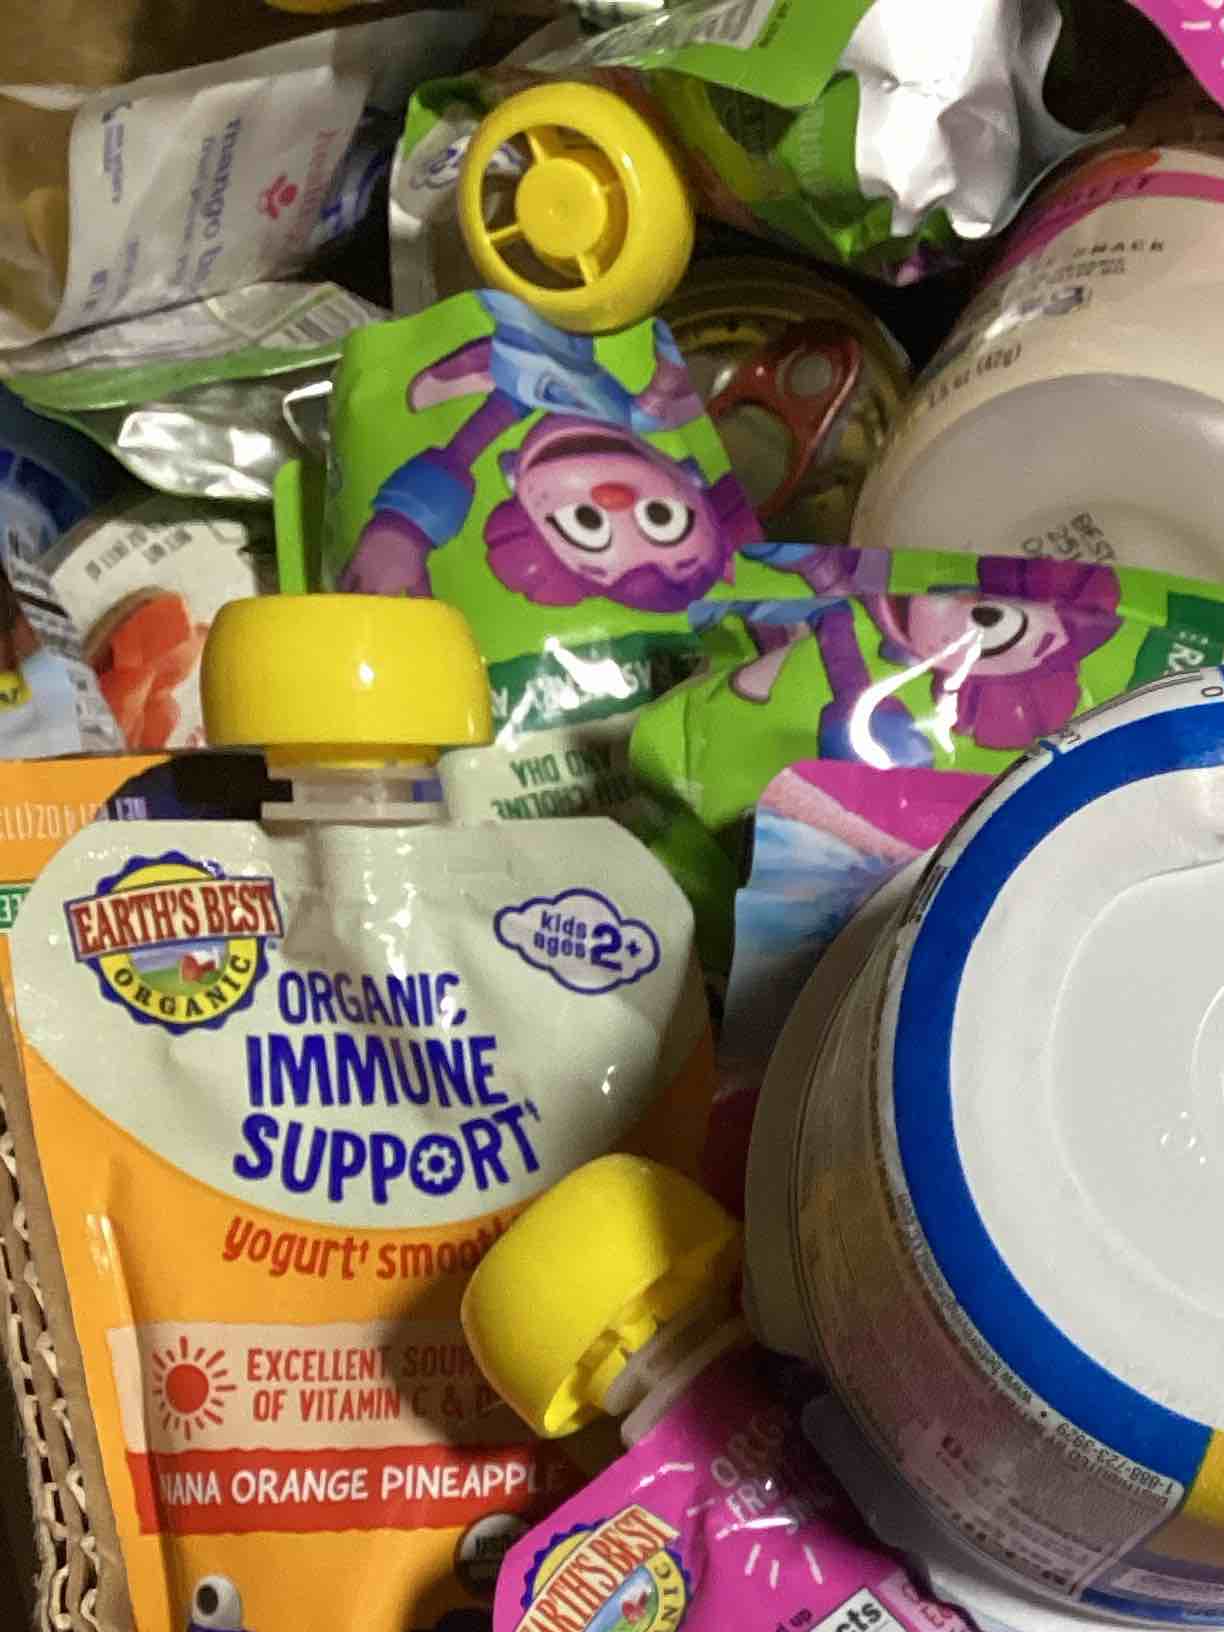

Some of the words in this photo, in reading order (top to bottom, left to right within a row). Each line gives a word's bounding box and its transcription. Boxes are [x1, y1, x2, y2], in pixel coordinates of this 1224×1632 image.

[71, 883, 202, 954] EARTH'S
[205, 879, 277, 938] BEST
[540, 911, 588, 940] kids
[533, 930, 587, 960] ages
[113, 954, 253, 1020] ORGANIC
[277, 971, 468, 1027] ORGANIC
[246, 1034, 509, 1109] IMMUNE
[246, 1348, 388, 1382] EXCELLENT
[252, 1387, 286, 1423] OF
[299, 1386, 401, 1423] VITAMIN
[231, 1467, 369, 1505] ORANGE
[381, 1459, 540, 1502] PINEAPPL
[586, 1497, 673, 1584] BEST
